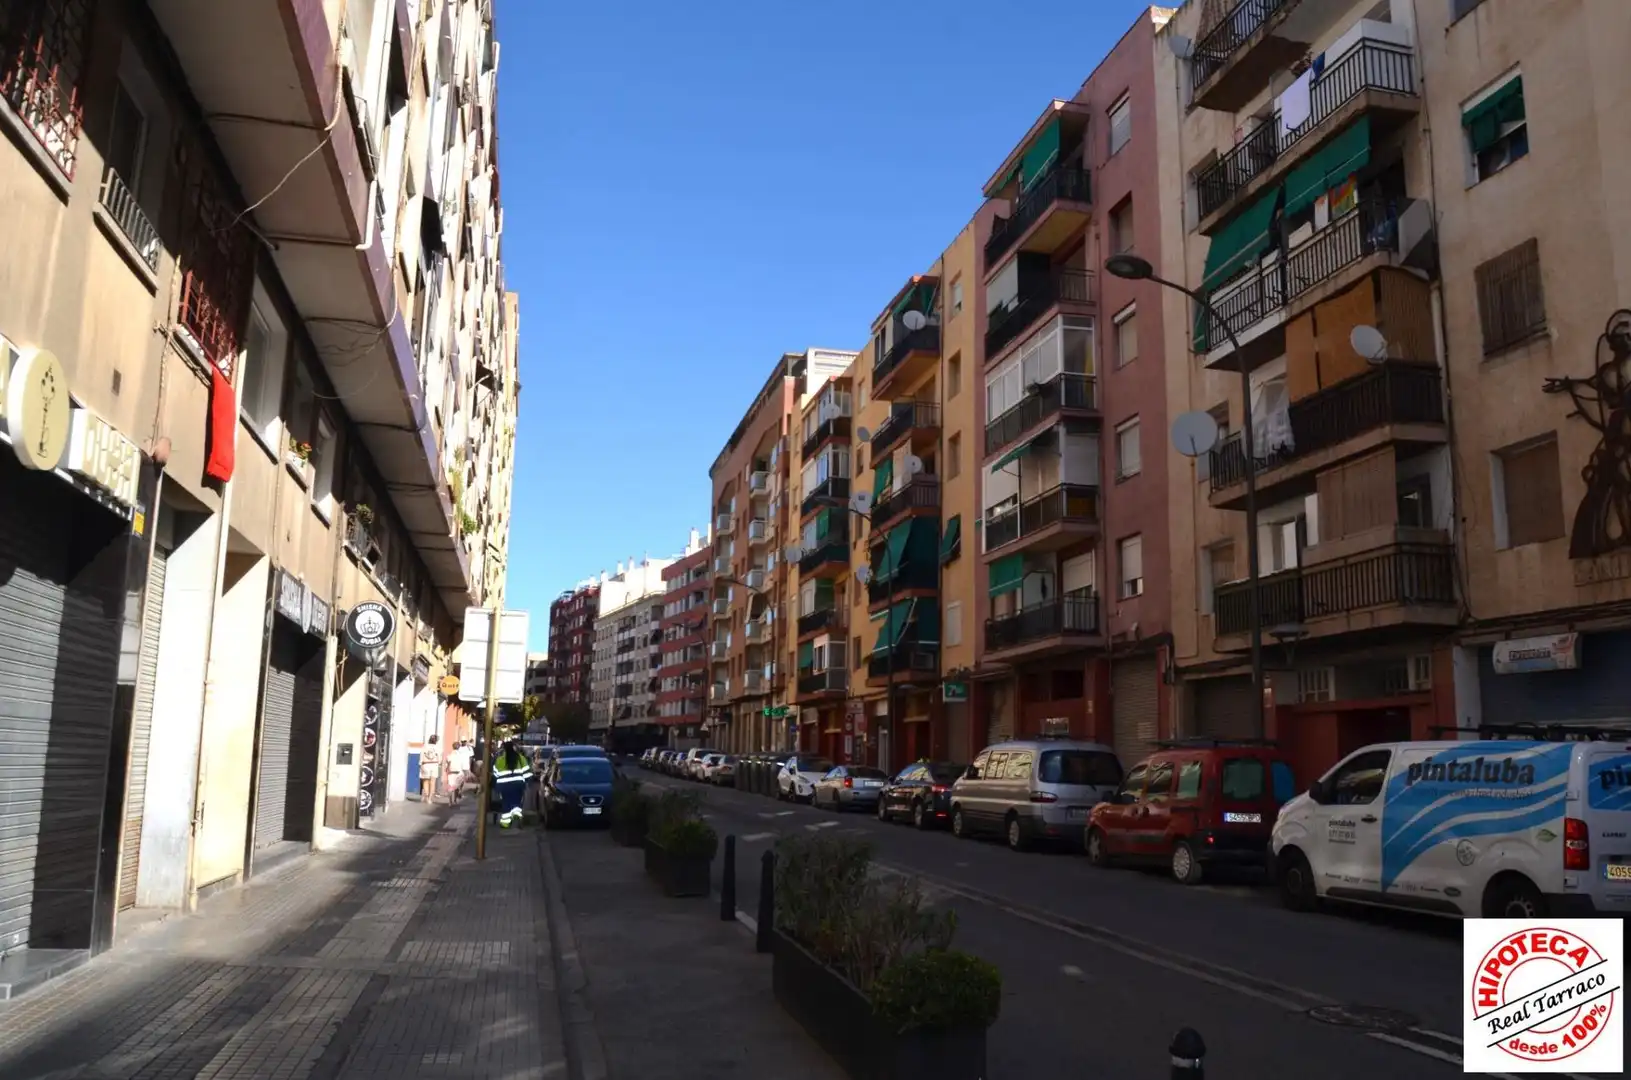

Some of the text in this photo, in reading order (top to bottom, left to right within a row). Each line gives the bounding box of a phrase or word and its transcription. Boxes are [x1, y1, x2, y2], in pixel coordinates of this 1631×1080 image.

[356, 603, 383, 613] SHISHA
[359, 636, 382, 646] DUBAI
[1405, 756, 1535, 786] pintaluba
